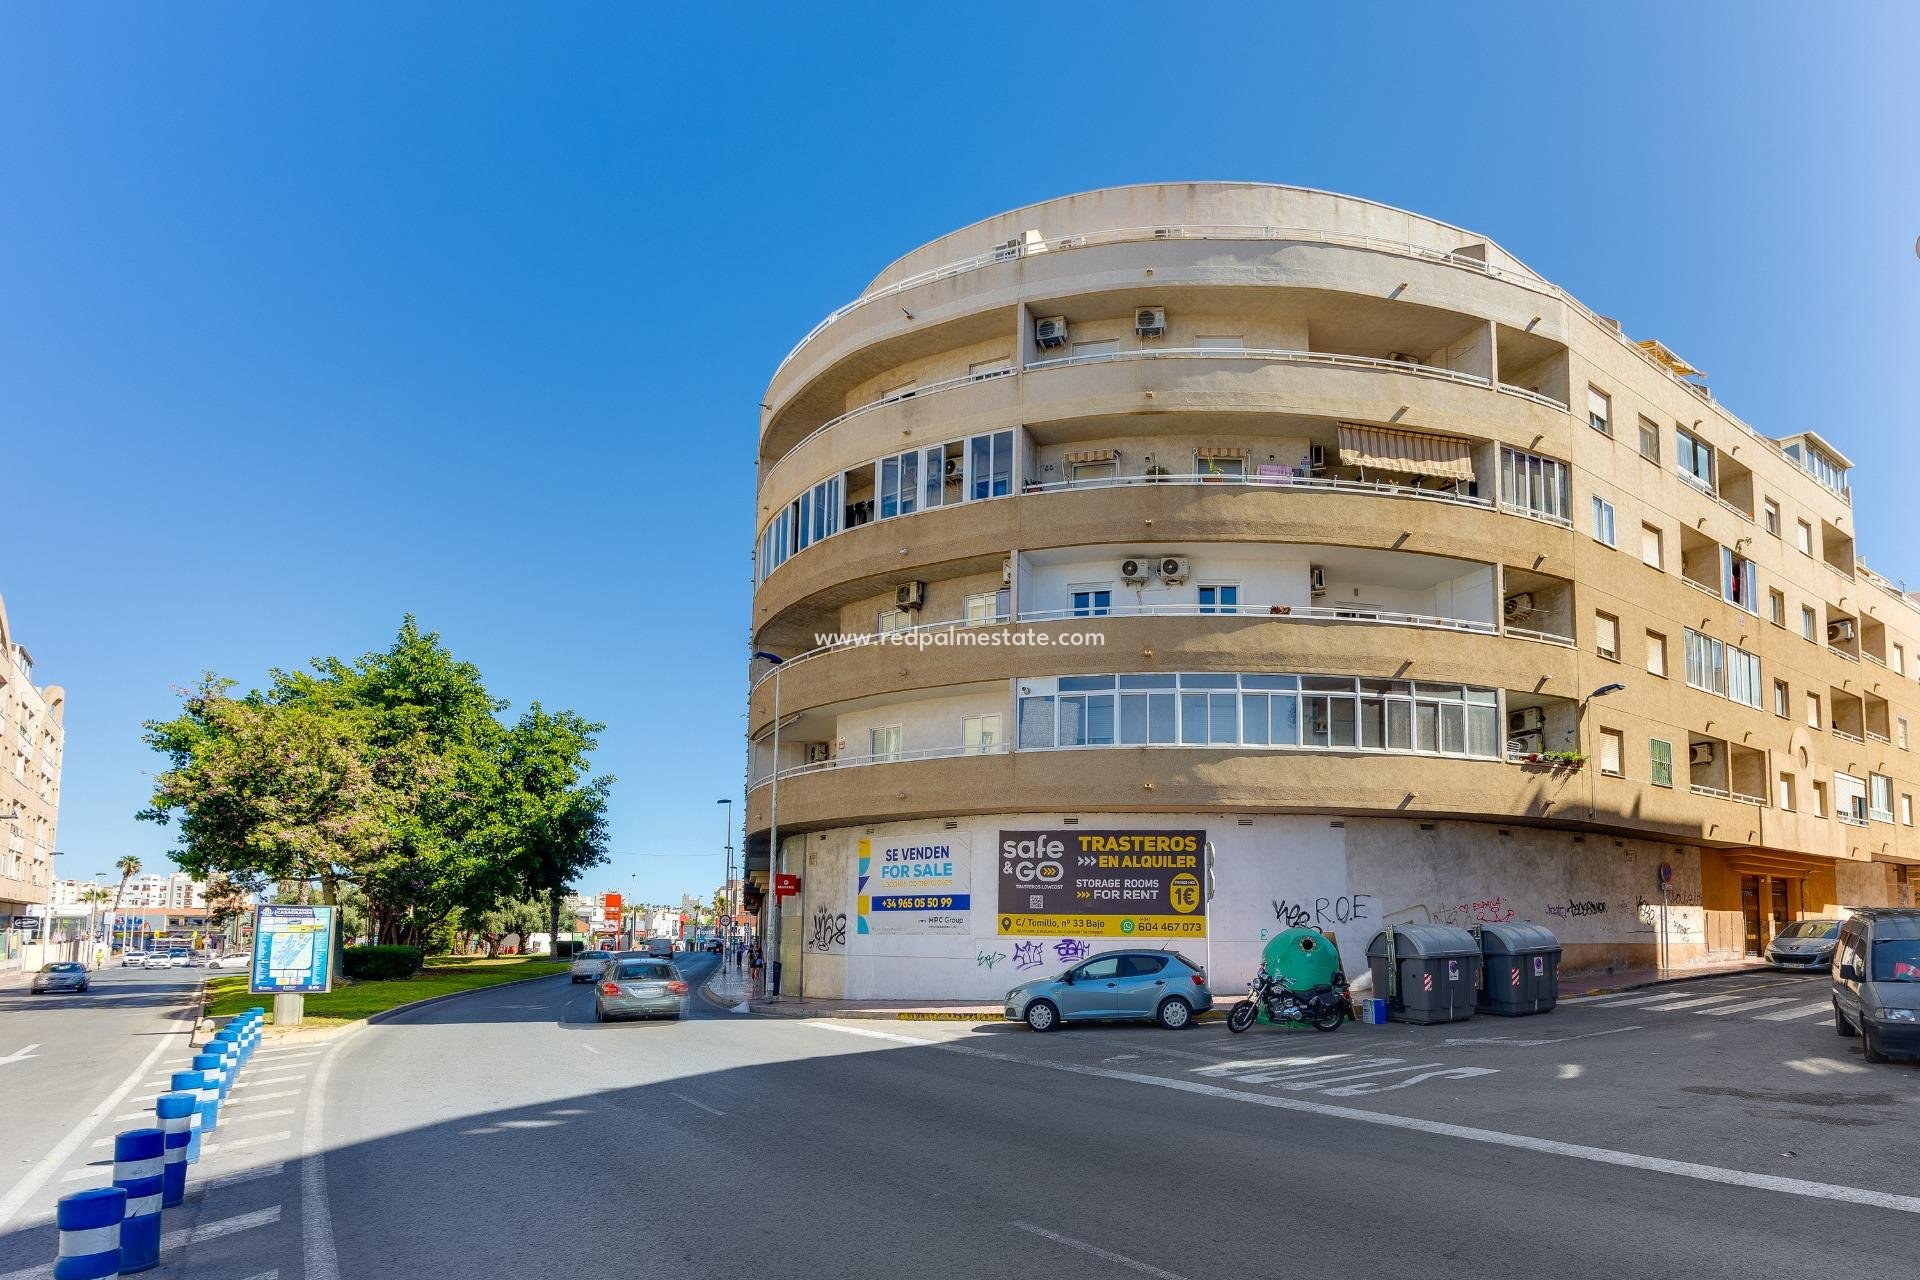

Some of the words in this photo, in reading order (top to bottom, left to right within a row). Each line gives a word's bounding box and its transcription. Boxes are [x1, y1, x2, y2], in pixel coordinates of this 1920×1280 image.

[1003, 834, 1065, 859] safe
[1078, 836, 1197, 852] TRASTEROS
[885, 848, 899, 862] SE
[901, 845, 950, 861] VENDEN
[1098, 855, 1119, 868] EN
[1121, 855, 1197, 868] ALQUILER
[881, 864, 910, 879] FOR
[913, 862, 953, 878] SALE
[1002, 860, 1014, 875] &
[1015, 861, 1065, 882] GO
[1075, 879, 1121, 888] STORAGE
[1124, 879, 1160, 888] ROOMS
[1093, 890, 1121, 900] FOR
[1123, 890, 1160, 900] RENT
[1174, 888, 1196, 905] 1€
[882, 899, 897, 908] +34
[898, 898, 912, 908] 965
[914, 898, 926, 908] 05
[927, 898, 939, 908] 50
[940, 897, 953, 908] 99
[944, 916, 964, 925] Group
[1027, 919, 1059, 929] Tomillo,
[1072, 920, 1084, 928] 33
[1086, 920, 1105, 929] Bajo
[1138, 923, 1159, 932] 604
[1160, 923, 1180, 932] 467
[1182, 923, 1202, 932] 073
